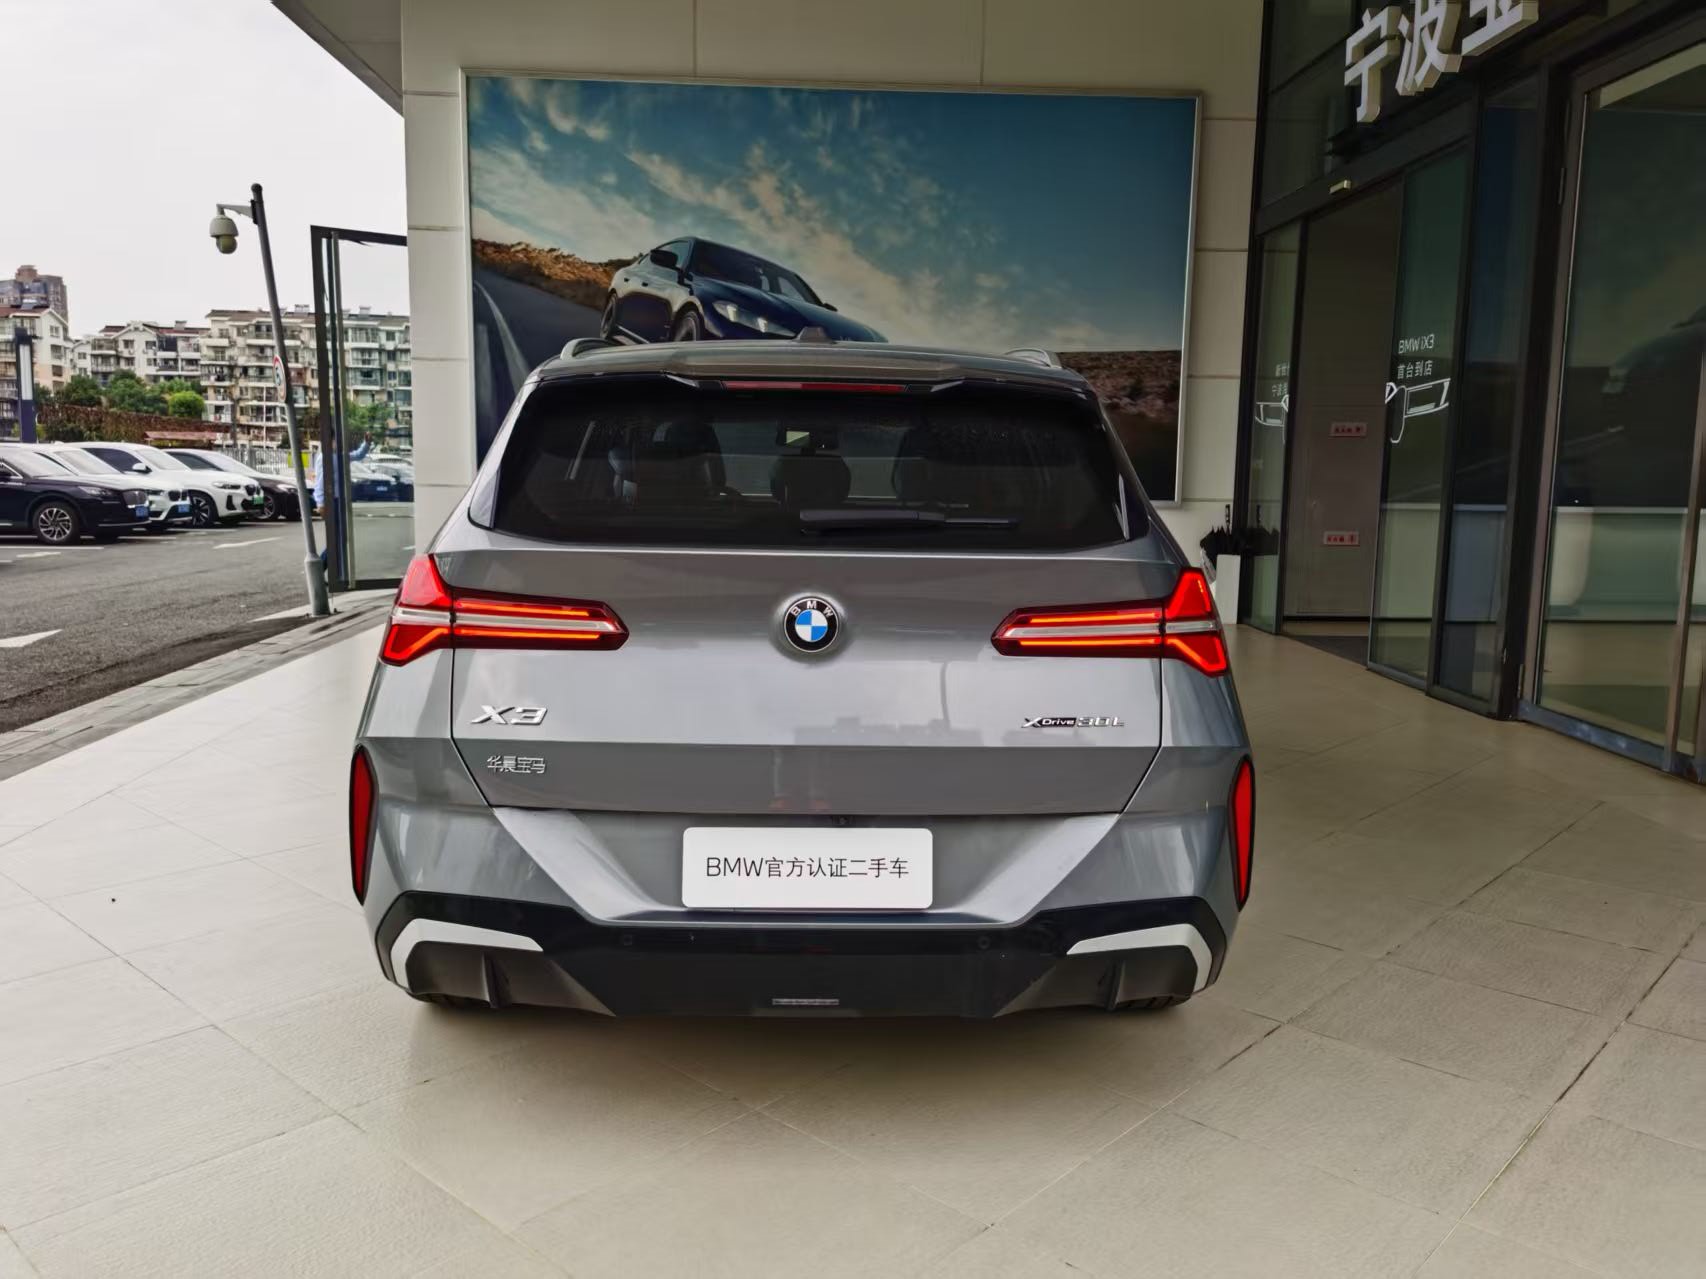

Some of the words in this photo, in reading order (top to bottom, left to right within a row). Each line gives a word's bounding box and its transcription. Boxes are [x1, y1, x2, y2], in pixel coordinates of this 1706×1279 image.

[1398, 336, 1420, 354] BMW
[1421, 333, 1435, 351] iX3
[1397, 360, 1433, 379] 首台到店
[790, 600, 834, 617] BMW
[470, 704, 548, 726] X3
[487, 755, 546, 774] 华晨宝马
[706, 856, 909, 878] BMW官方认证二手车
